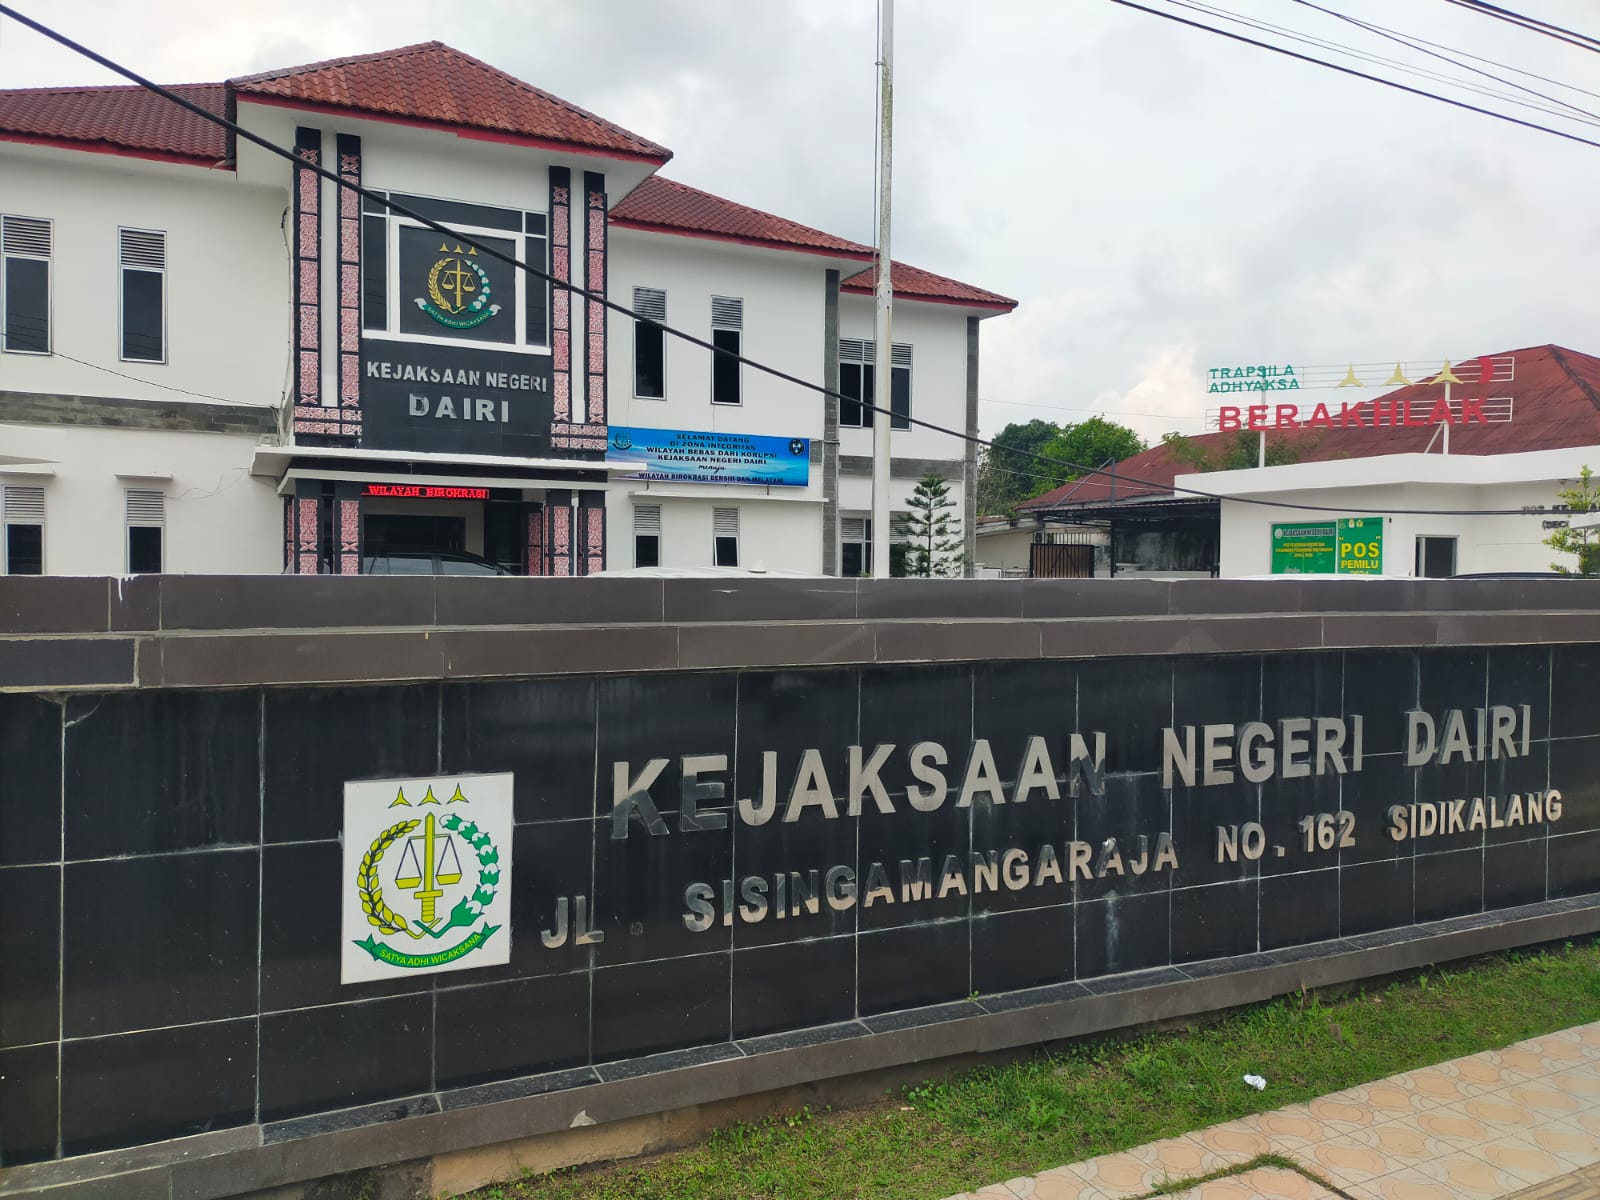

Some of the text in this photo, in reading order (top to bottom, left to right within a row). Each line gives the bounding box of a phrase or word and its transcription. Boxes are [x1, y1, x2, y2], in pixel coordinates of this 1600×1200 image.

[367, 361, 547, 393] KEJAKSAAN NEGERI
[1209, 364, 1295, 379] TRAPSILA
[1207, 378, 1301, 393] ADHYAKSA
[408, 393, 509, 423] DAIRI
[1219, 395, 1489, 433] BERAKHLAK
[676, 433, 750, 444] SELAMAT DATANG
[646, 446, 685, 455] WILAYAH
[687, 448, 716, 456] BEBAS
[741, 451, 777, 459] KORUPSI
[707, 443, 756, 451] INTEGRITAS
[657, 454, 708, 463] KEJAKSAAN
[638, 472, 669, 480] WILAYAH
[671, 473, 709, 481] BIROKRASI
[368, 485, 487, 499] WILAYAH BIROKRASI
[1341, 559, 1379, 569] PEMILU
[611, 704, 1532, 839] KEJAKSAAN NEGERI DAIRI
[682, 832, 1180, 932] SISINGAMANGARAJA
[1298, 810, 1357, 853] 162
[1386, 789, 1563, 842] SIDIKALANG
[380, 934, 481, 966] SATYA ADHI WICAKSANA
